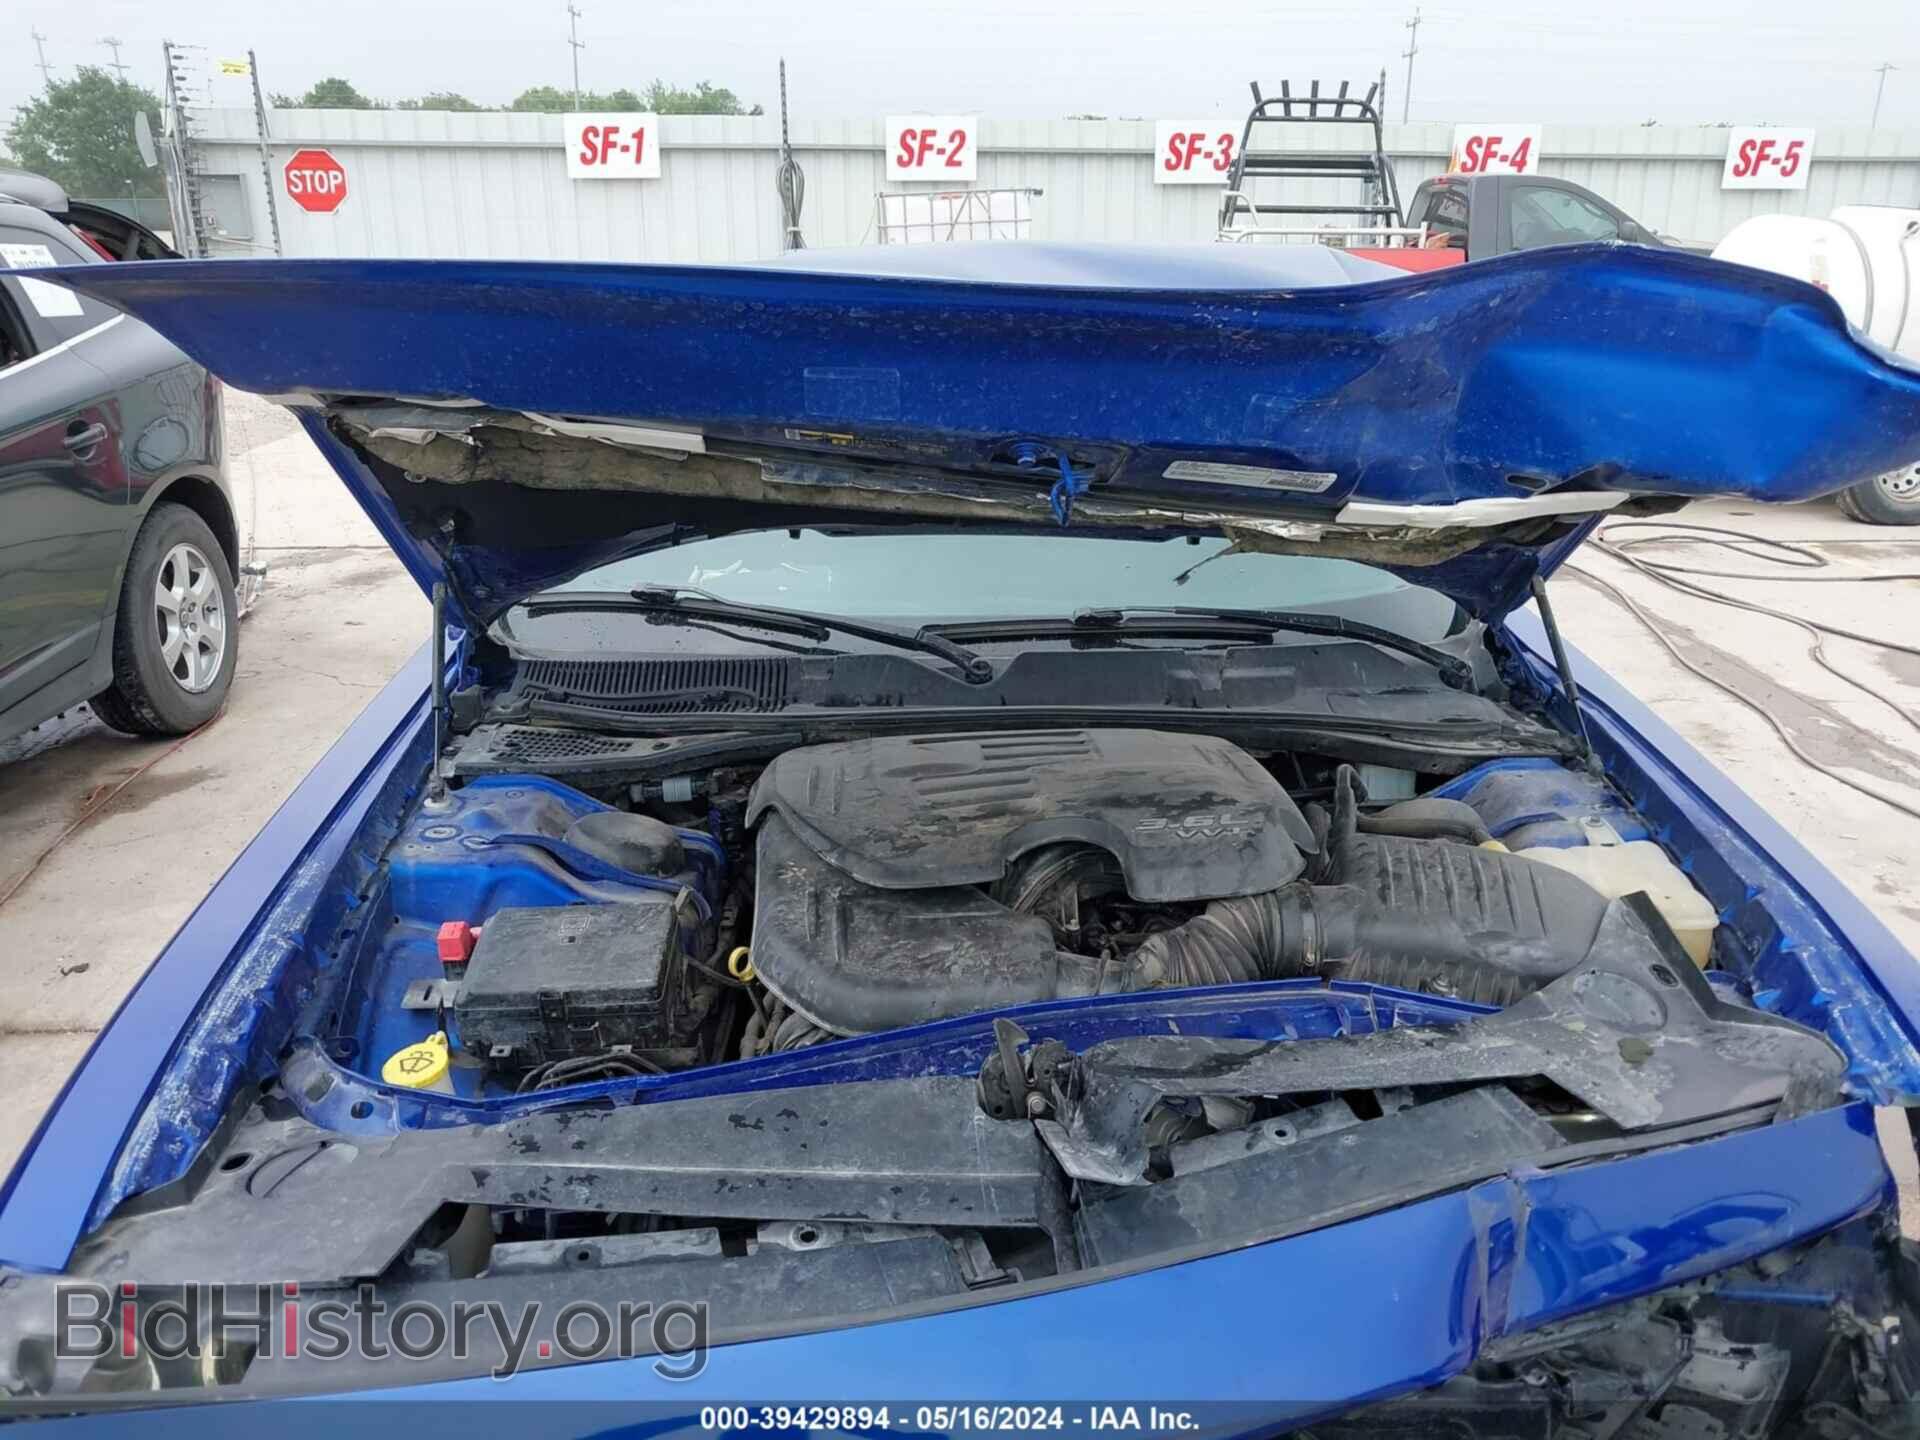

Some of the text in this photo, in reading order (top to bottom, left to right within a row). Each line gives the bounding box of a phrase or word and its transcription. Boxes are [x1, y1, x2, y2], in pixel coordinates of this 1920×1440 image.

[580, 125, 645, 166] SF-1
[896, 128, 967, 168] SF-2
[1164, 132, 1235, 171] SF-3
[1460, 135, 1532, 173] SF-4
[1732, 138, 1805, 177] SF-5
[289, 169, 343, 194] STOP
